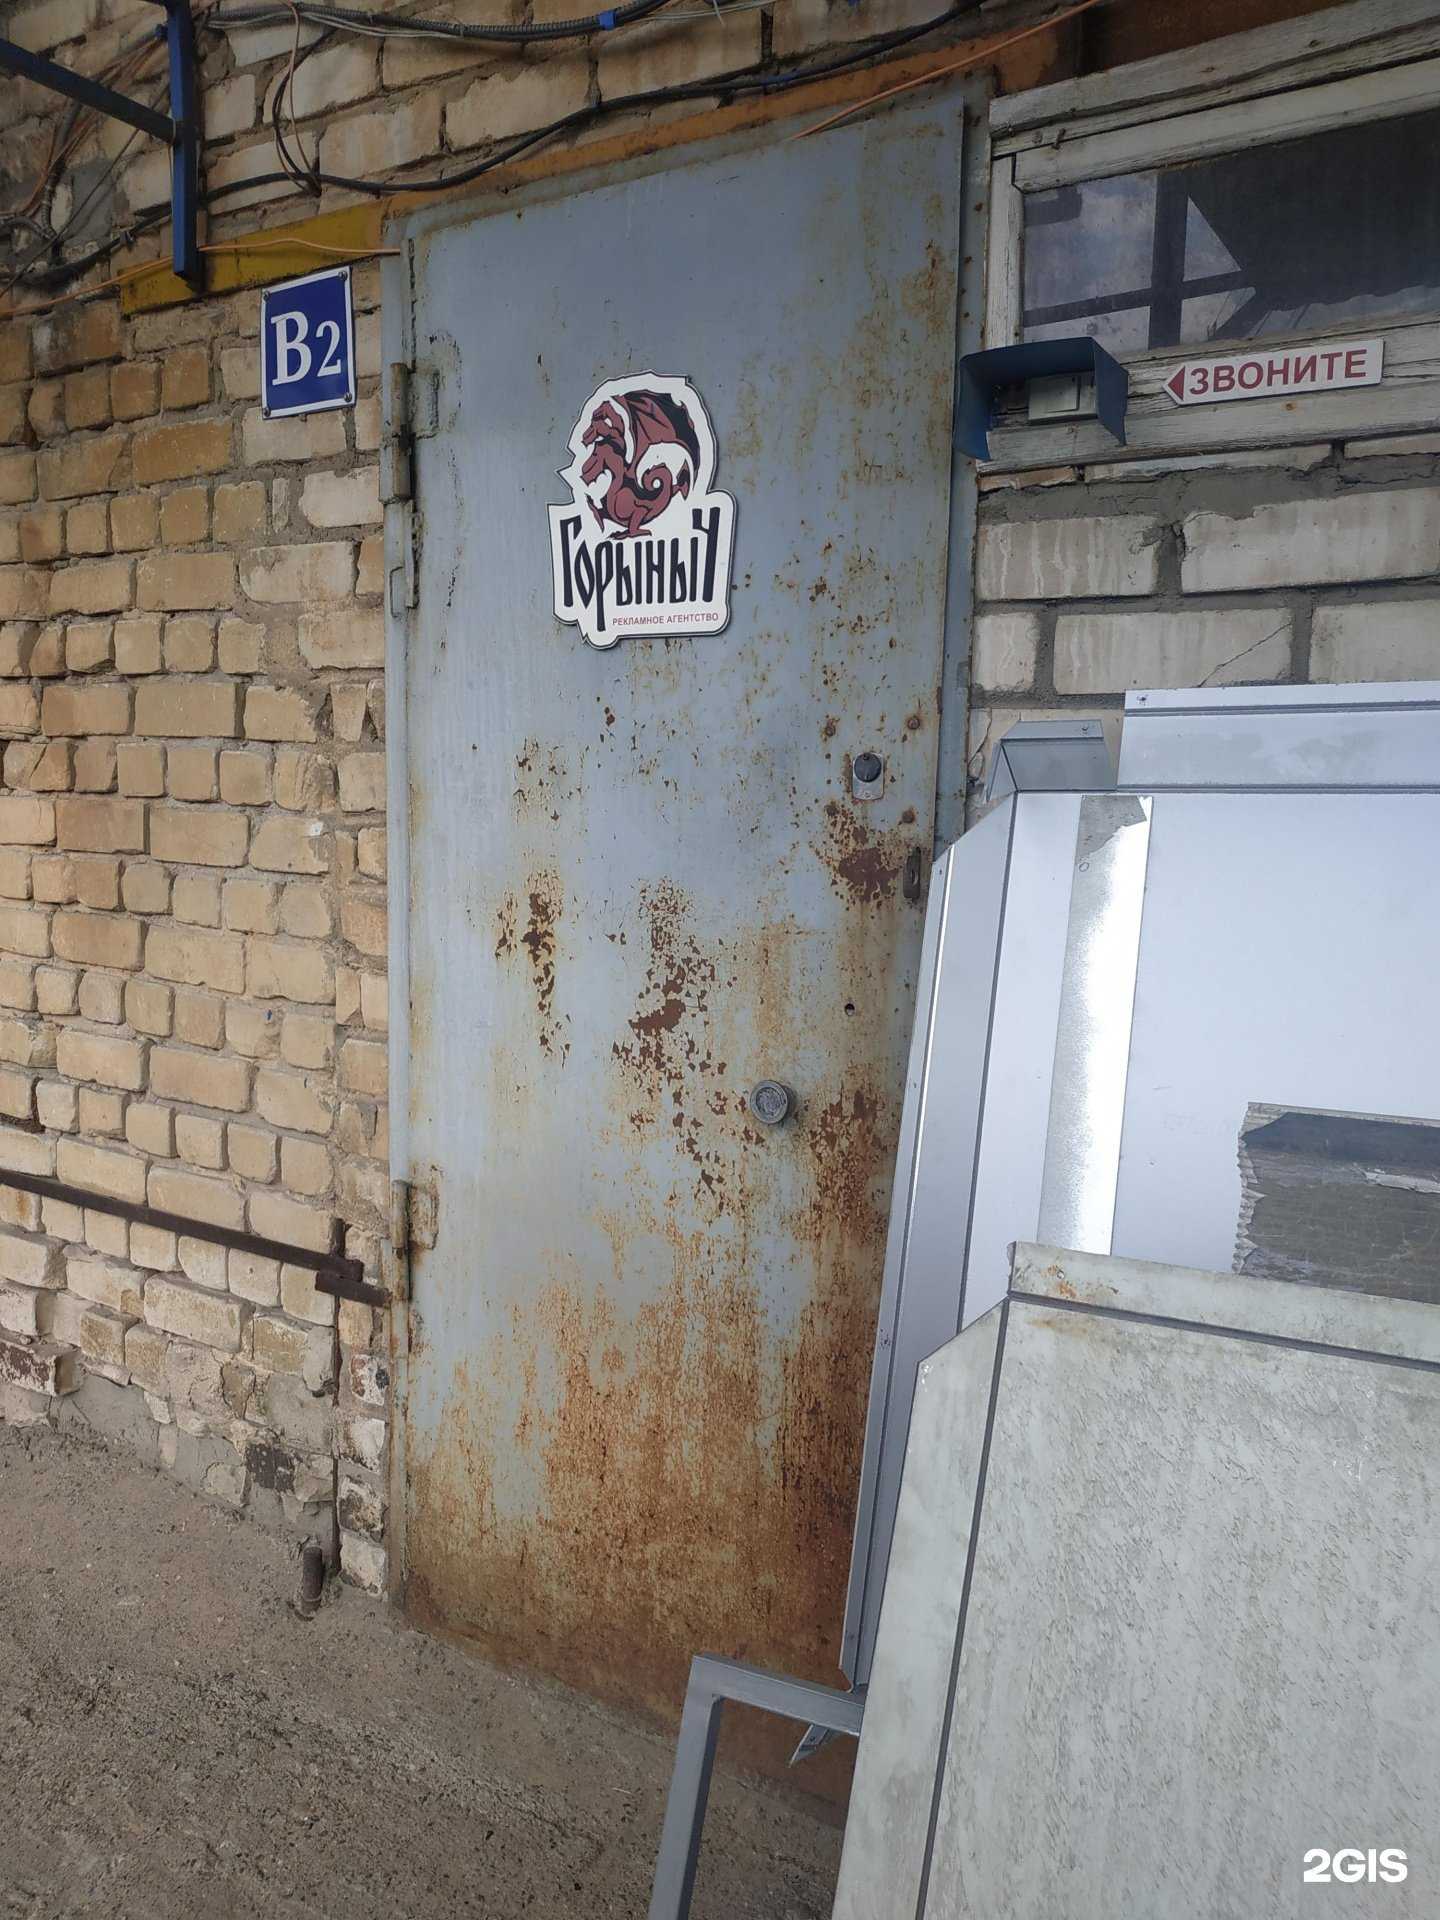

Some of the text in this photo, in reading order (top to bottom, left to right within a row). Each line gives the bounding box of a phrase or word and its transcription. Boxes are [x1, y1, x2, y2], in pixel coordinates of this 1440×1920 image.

[1189, 349, 1367, 395] ЗВОНИТЕ
[612, 612, 719, 626] РЕКЛАМНОЕ АГЕНТСТВО
